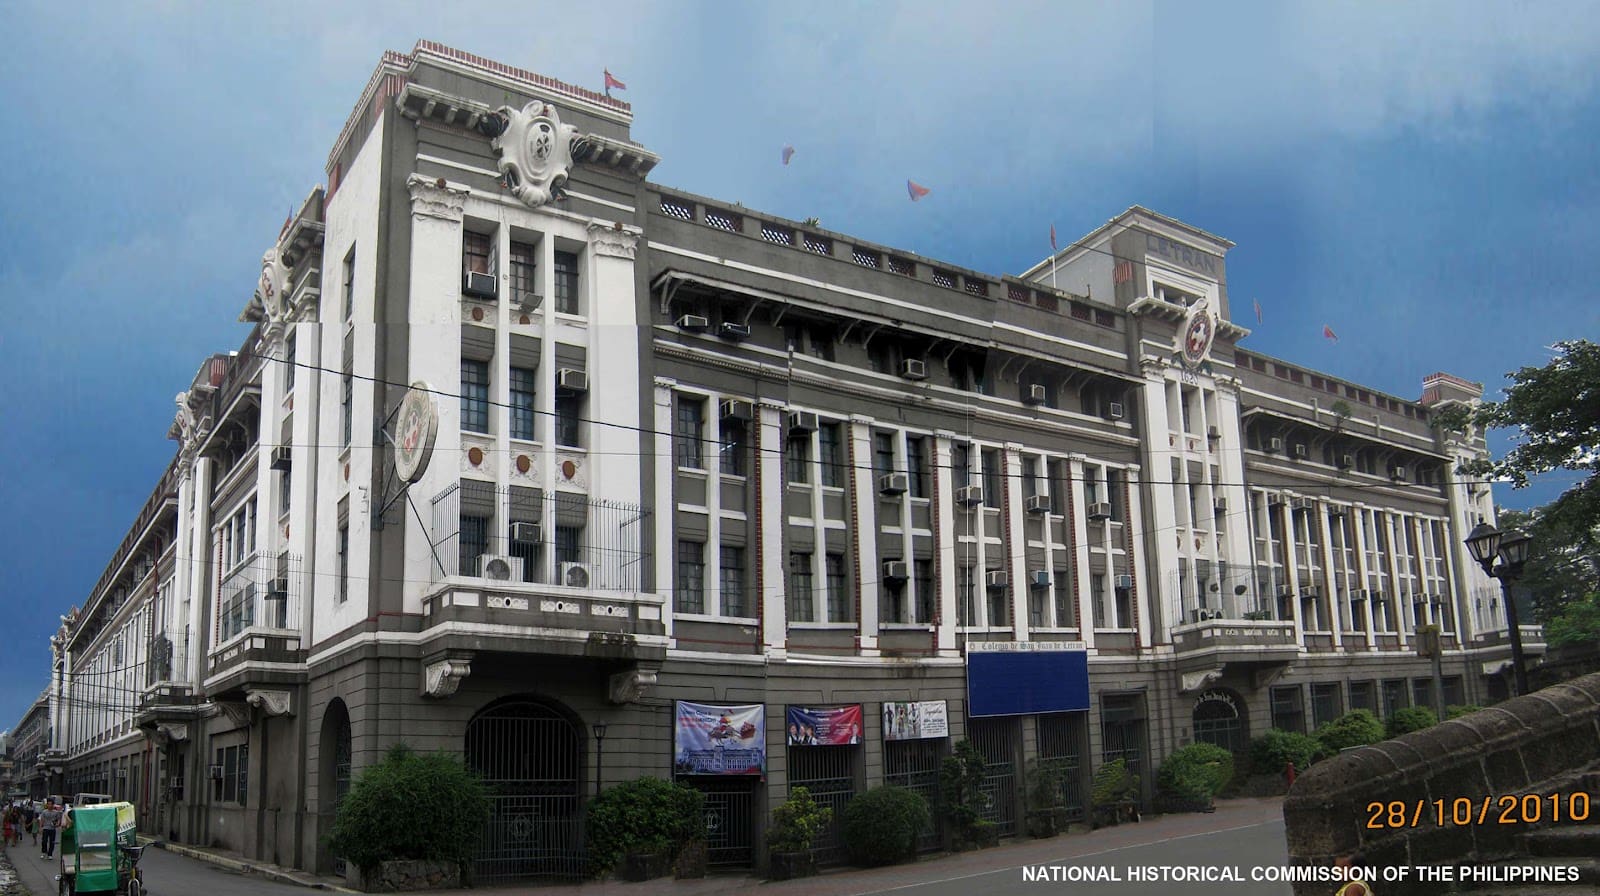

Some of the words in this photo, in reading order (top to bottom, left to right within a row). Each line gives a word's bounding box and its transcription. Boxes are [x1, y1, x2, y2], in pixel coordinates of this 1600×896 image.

[1146, 233, 1217, 274] LETRAN
[982, 642, 1009, 652] Colegio
[1010, 642, 1018, 650] de
[1020, 641, 1035, 650] San
[1037, 641, 1053, 651] Juan
[1053, 641, 1060, 649] de
[1063, 641, 1083, 650] Letran
